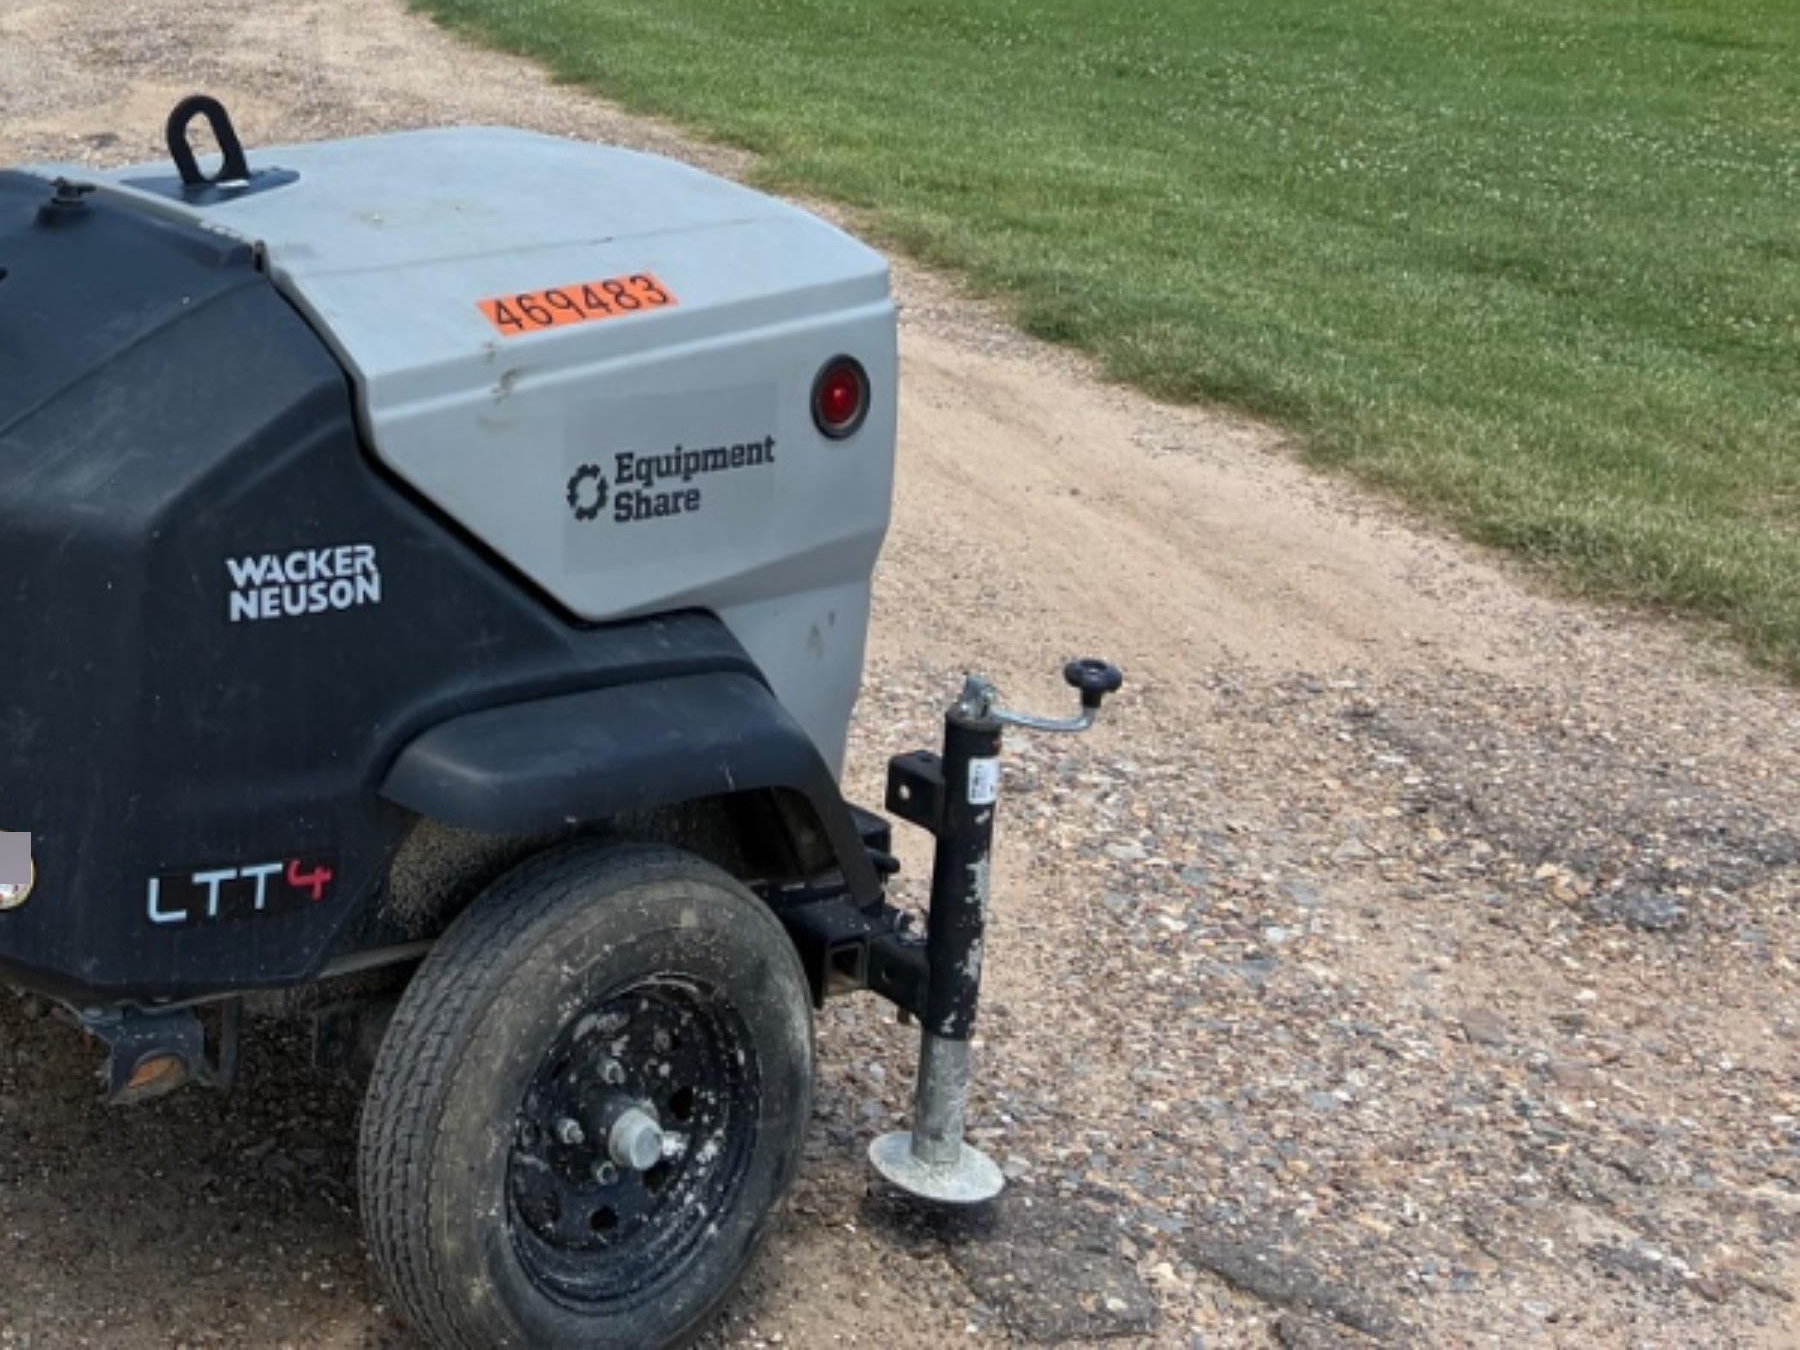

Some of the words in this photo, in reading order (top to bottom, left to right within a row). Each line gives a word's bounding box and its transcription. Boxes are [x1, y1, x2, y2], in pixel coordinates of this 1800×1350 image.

[493, 274, 669, 330] 469483
[614, 434, 775, 488] Equipment
[614, 488, 701, 523] Share
[225, 544, 378, 588] WACKER
[229, 570, 382, 622] NEUSON
